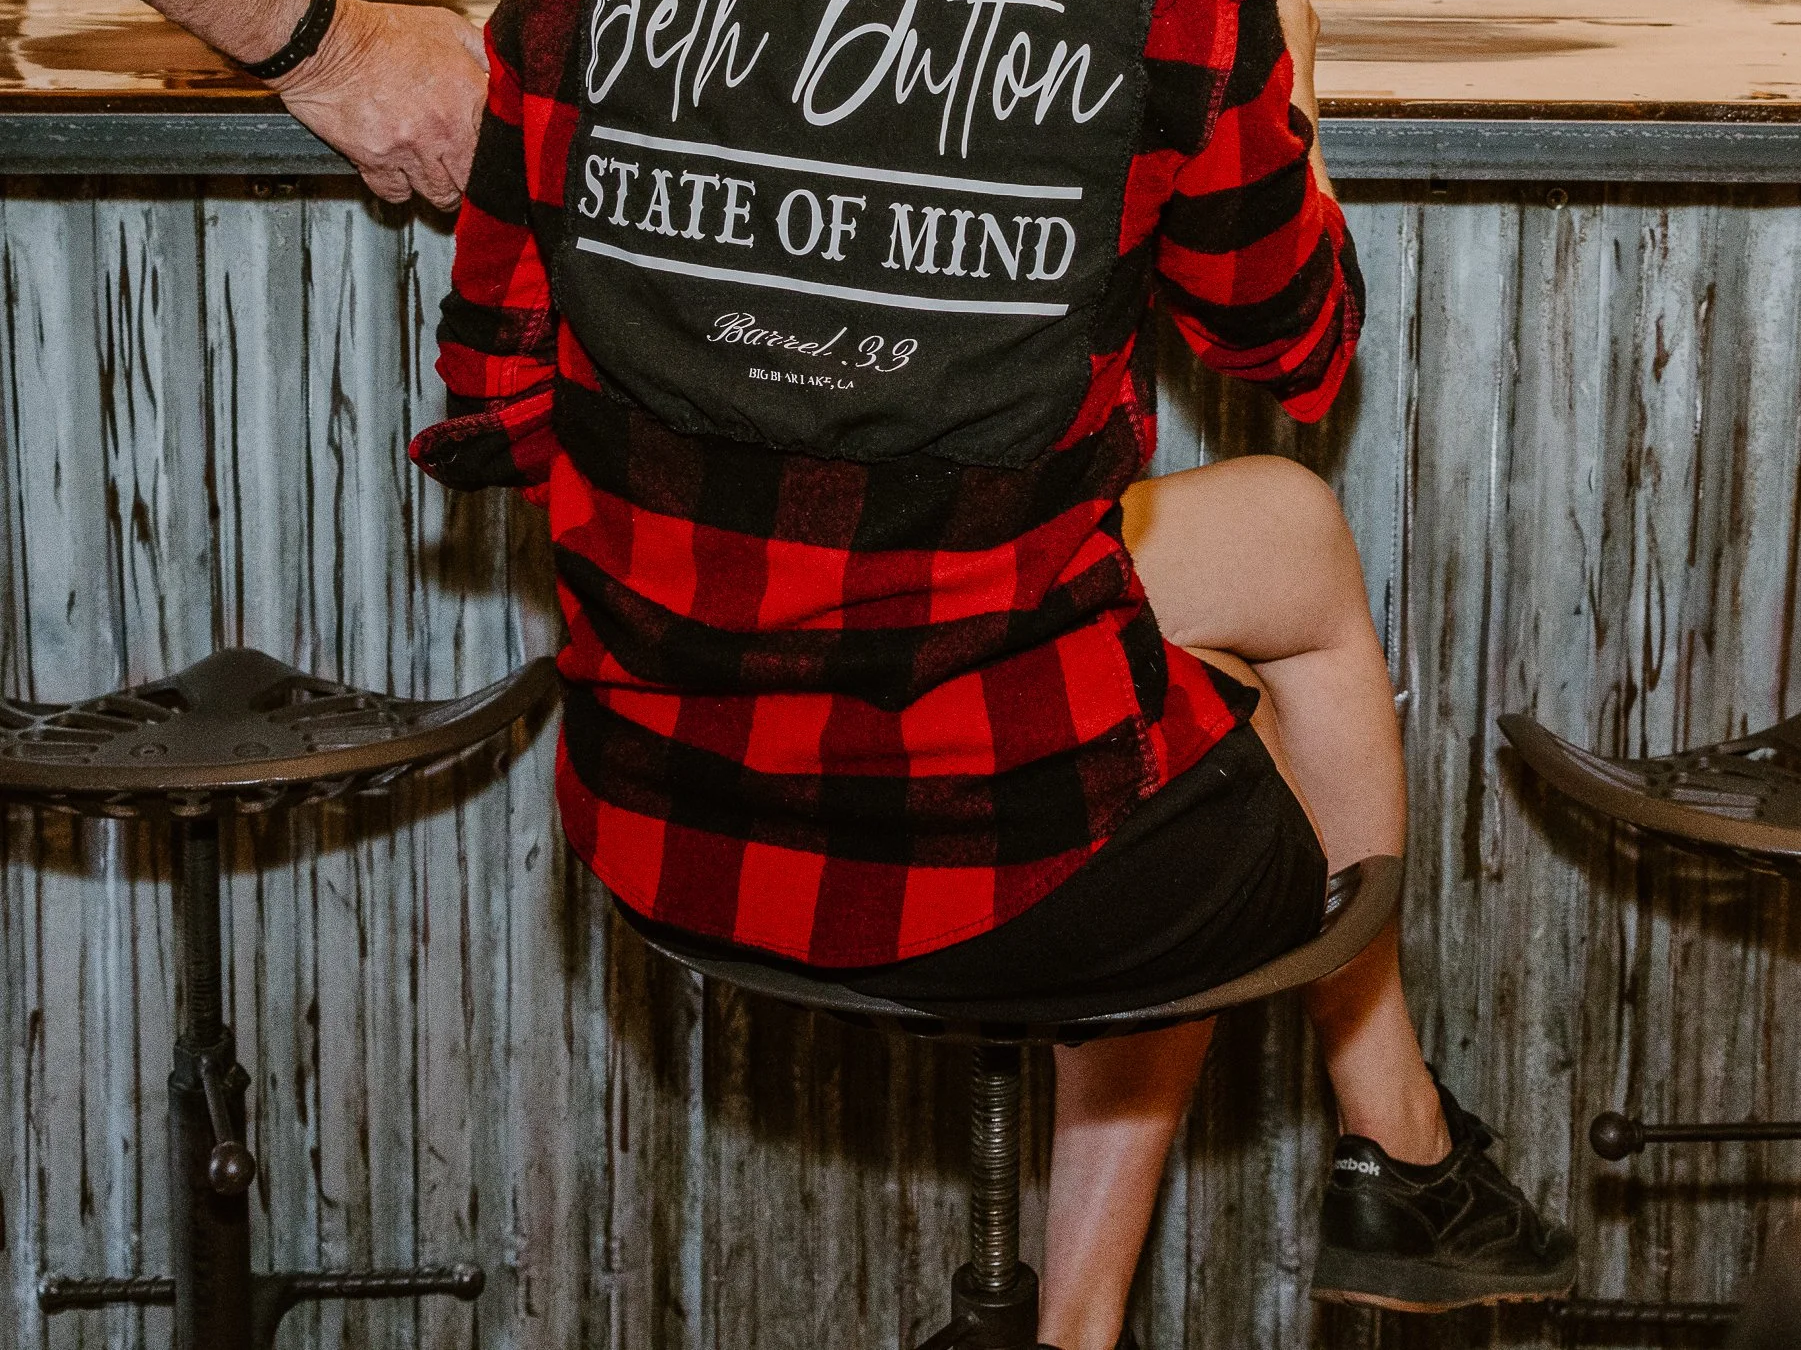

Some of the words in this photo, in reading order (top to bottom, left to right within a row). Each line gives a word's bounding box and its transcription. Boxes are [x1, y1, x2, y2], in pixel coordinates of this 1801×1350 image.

[578, 154, 757, 250] STATE
[775, 187, 869, 263] OF
[881, 201, 1077, 282] MIND
[706, 312, 848, 357] Barrel
[749, 367, 769, 380] BIG
